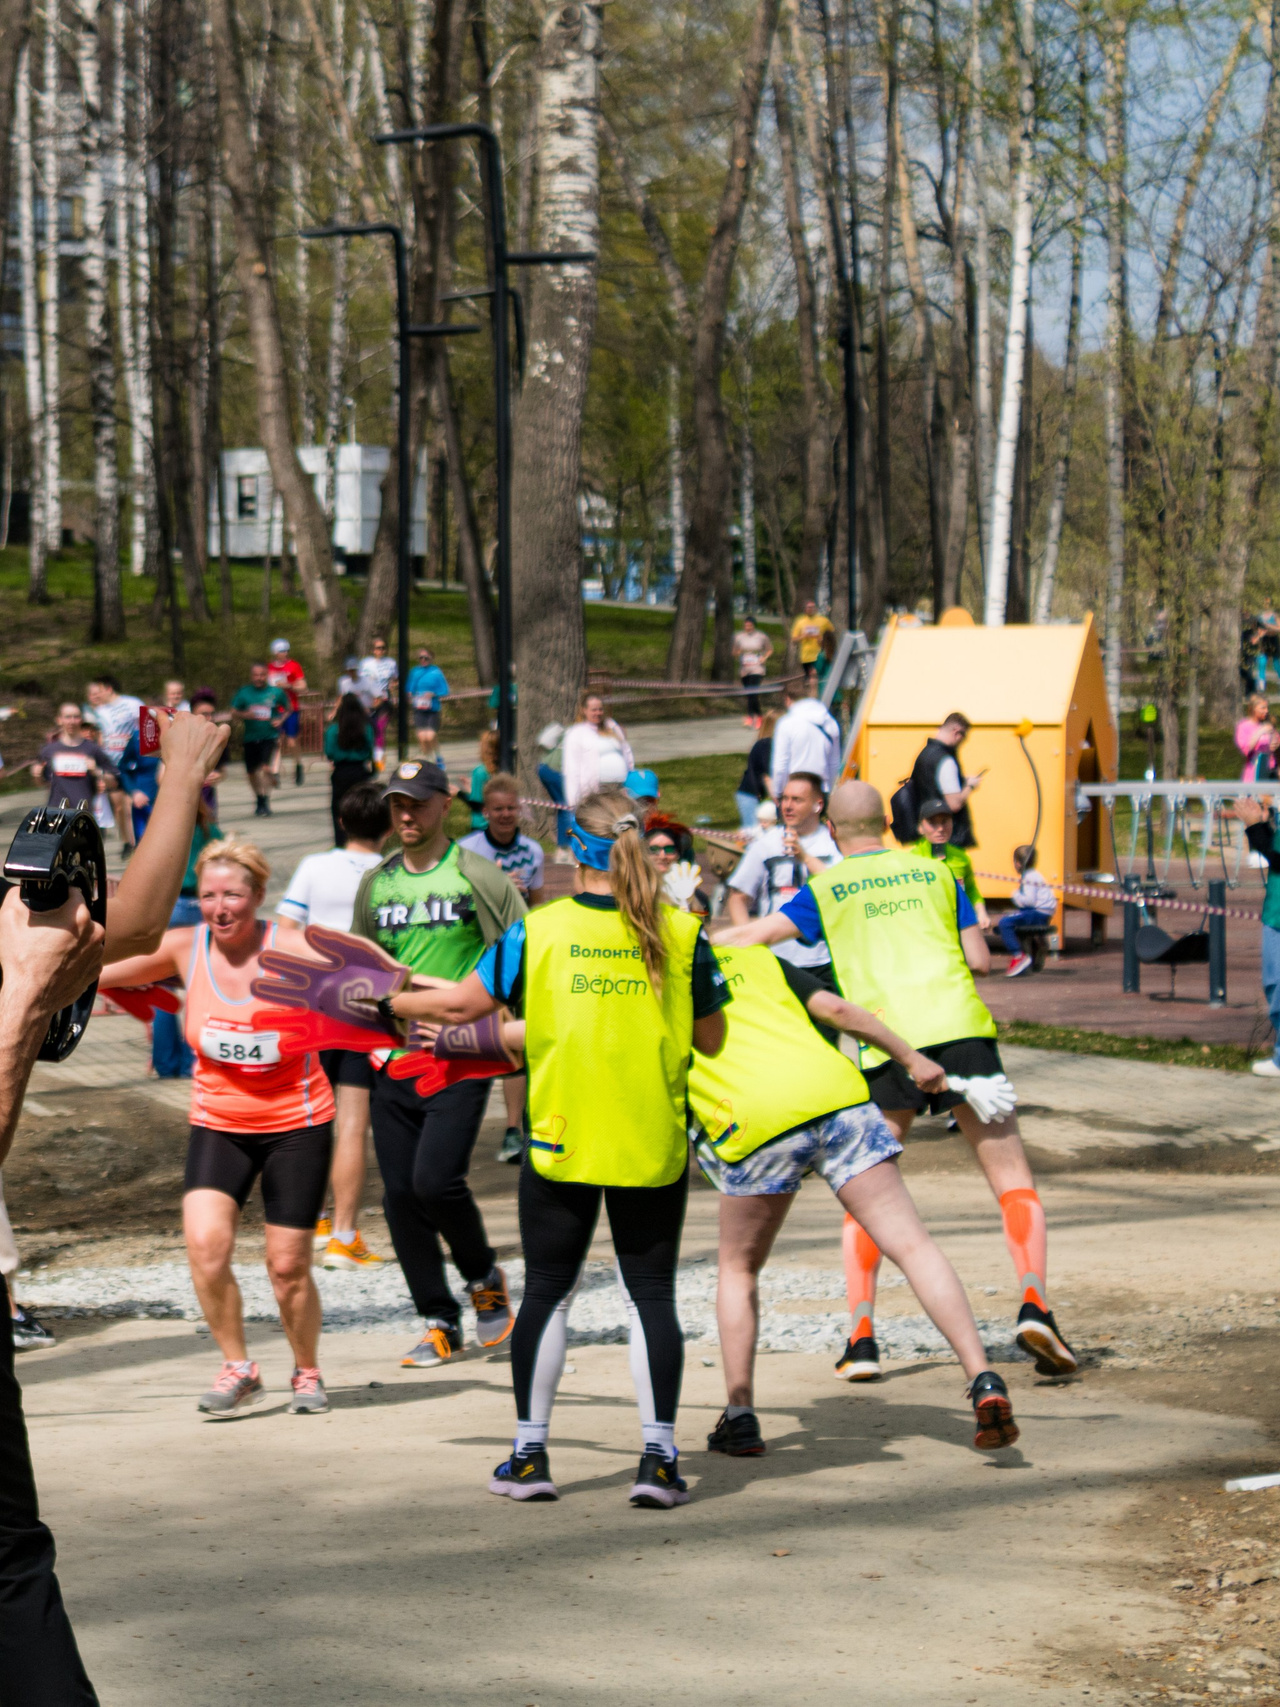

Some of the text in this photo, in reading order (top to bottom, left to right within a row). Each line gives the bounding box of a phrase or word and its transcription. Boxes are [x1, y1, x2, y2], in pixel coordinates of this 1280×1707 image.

[831, 868, 936, 903] Волонтёр
[377, 899, 460, 928] TRAIL
[218, 1042, 264, 1061] 584
